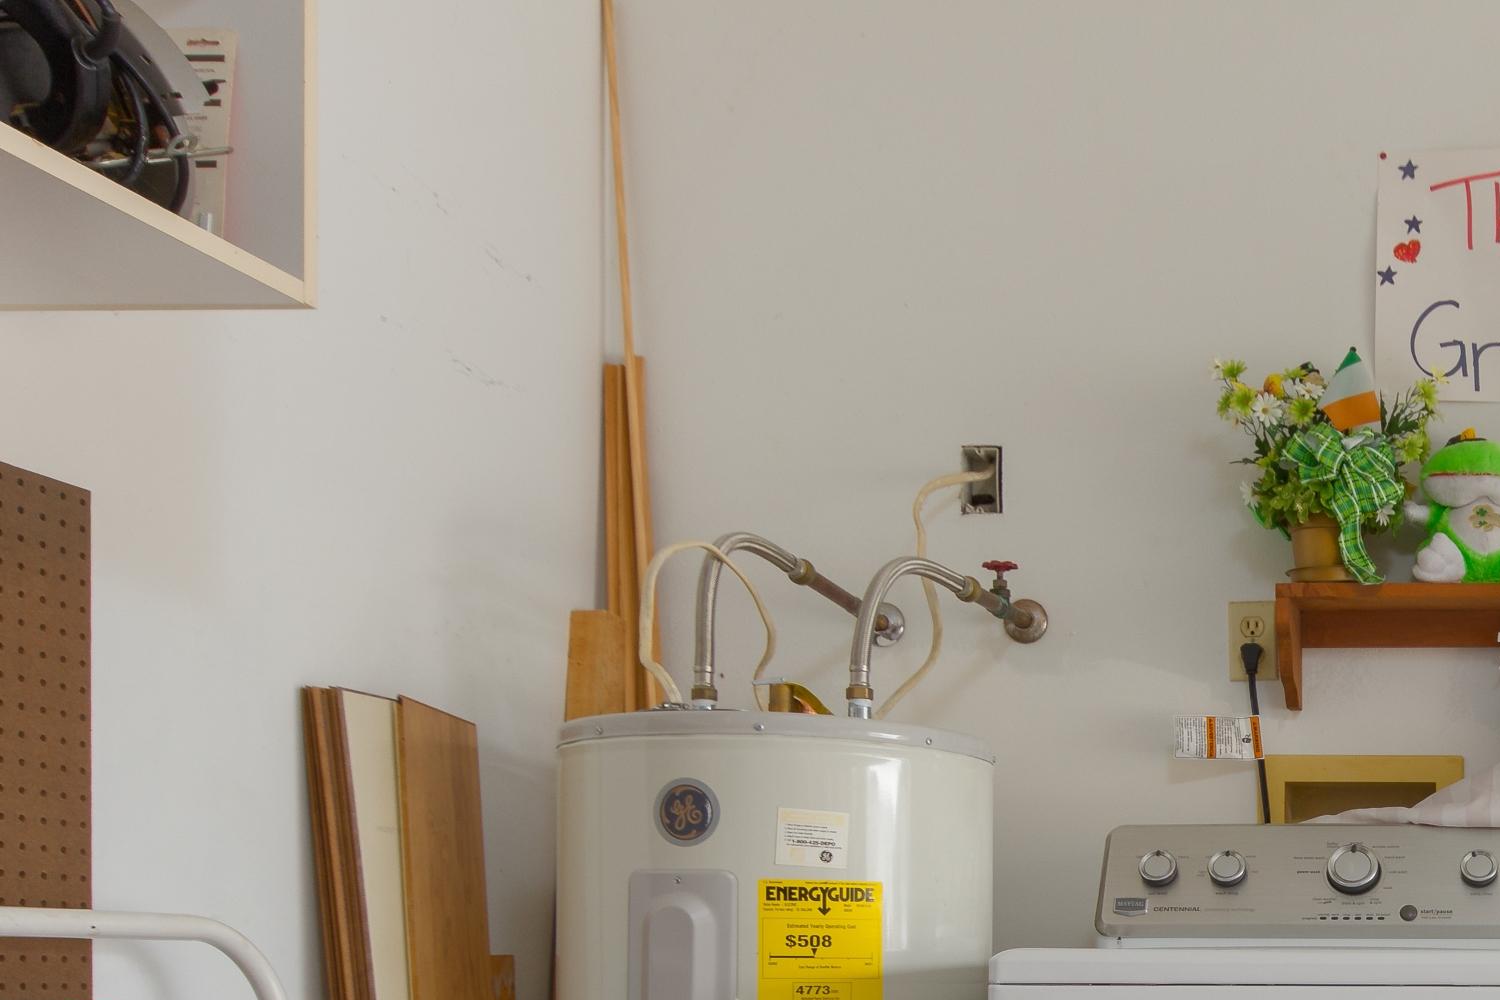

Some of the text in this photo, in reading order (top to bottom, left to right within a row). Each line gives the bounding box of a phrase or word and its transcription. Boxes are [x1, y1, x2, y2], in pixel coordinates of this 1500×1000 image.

[766, 886, 875, 903] ENERGYGUIDE
[785, 934, 832, 948] $508
[796, 985, 831, 995] 4773
